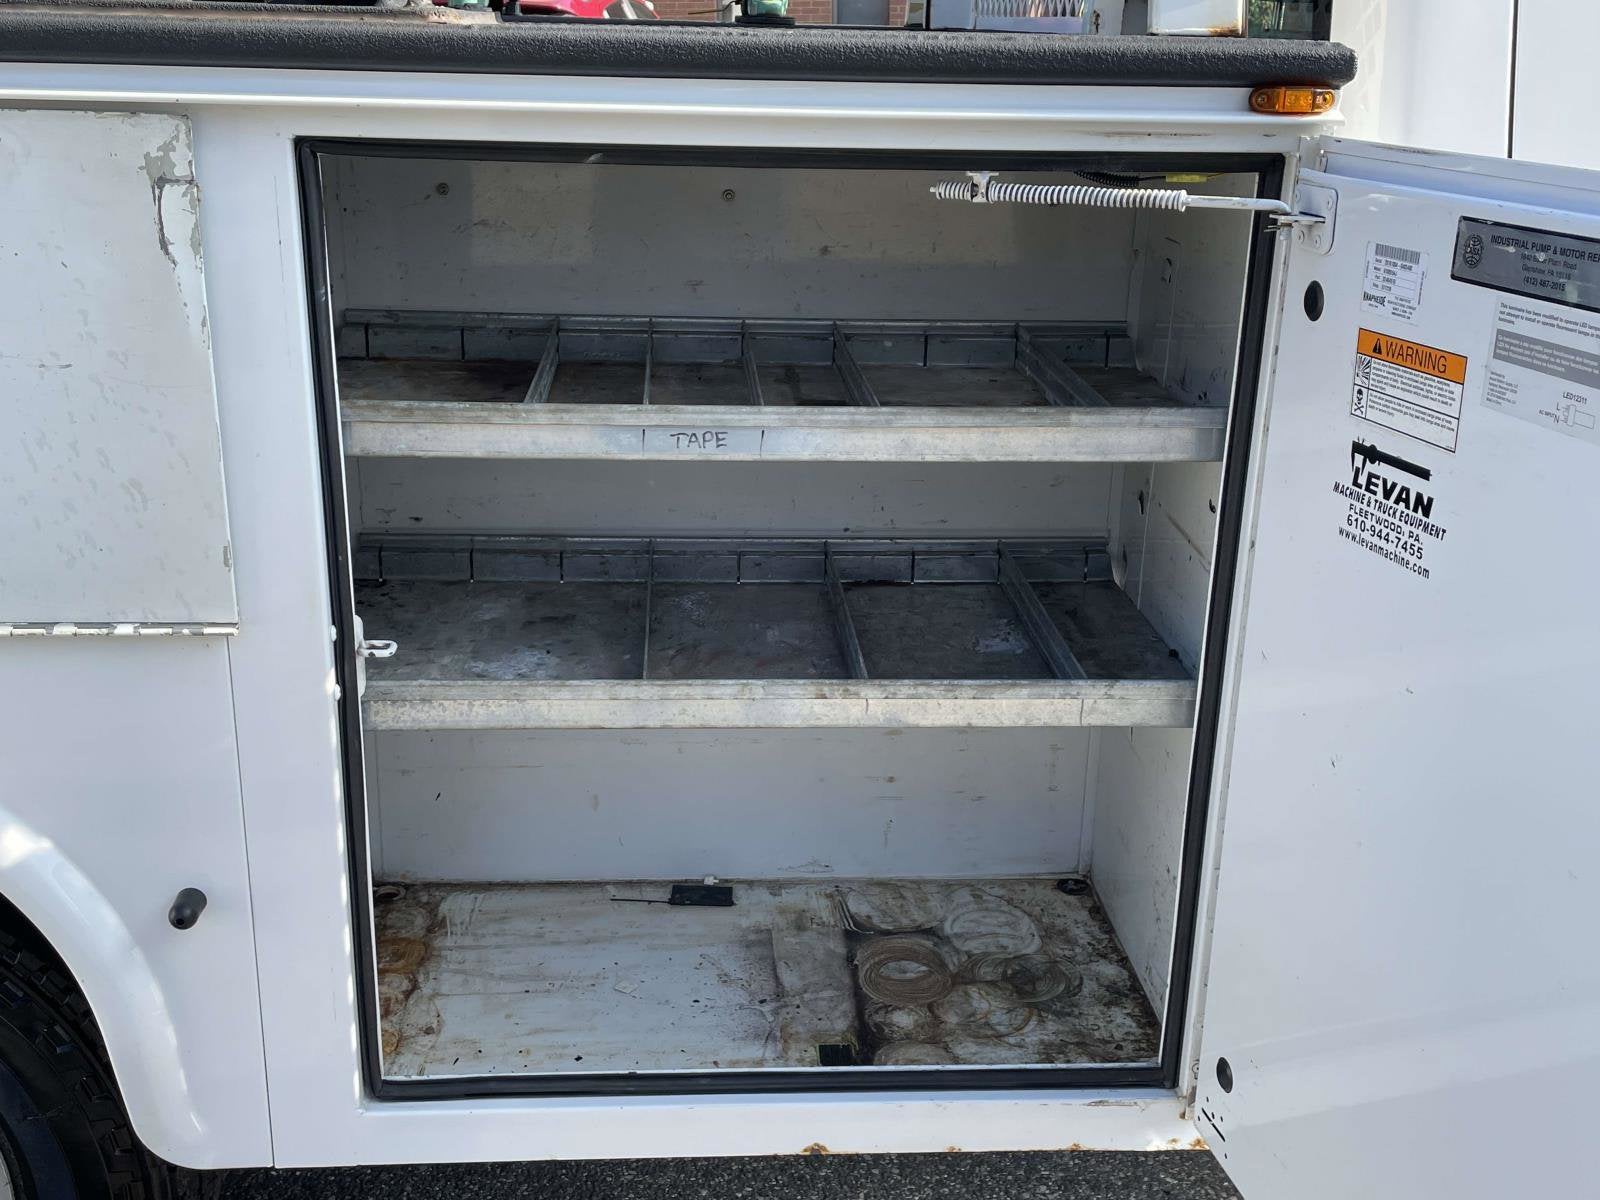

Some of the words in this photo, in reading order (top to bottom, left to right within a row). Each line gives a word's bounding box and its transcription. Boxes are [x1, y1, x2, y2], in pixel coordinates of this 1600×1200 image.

[1490, 234, 1530, 249] INDUSTRIAL
[1531, 241, 1551, 253] PUMP
[1552, 246, 1558, 255] &
[1560, 247, 1586, 261] MOTOR
[1385, 340, 1447, 374] WARNING
[669, 430, 728, 449] TAPE
[1332, 481, 1366, 504] MACHINE
[1366, 495, 1372, 507] &
[1373, 499, 1398, 520] TRUCK
[1398, 512, 1447, 541] EQUIPMENT
[1351, 465, 1435, 519] LEVAN
[1338, 526, 1430, 580] www.levanmachine.com
[1346, 514, 1424, 560] 610-944-7455
